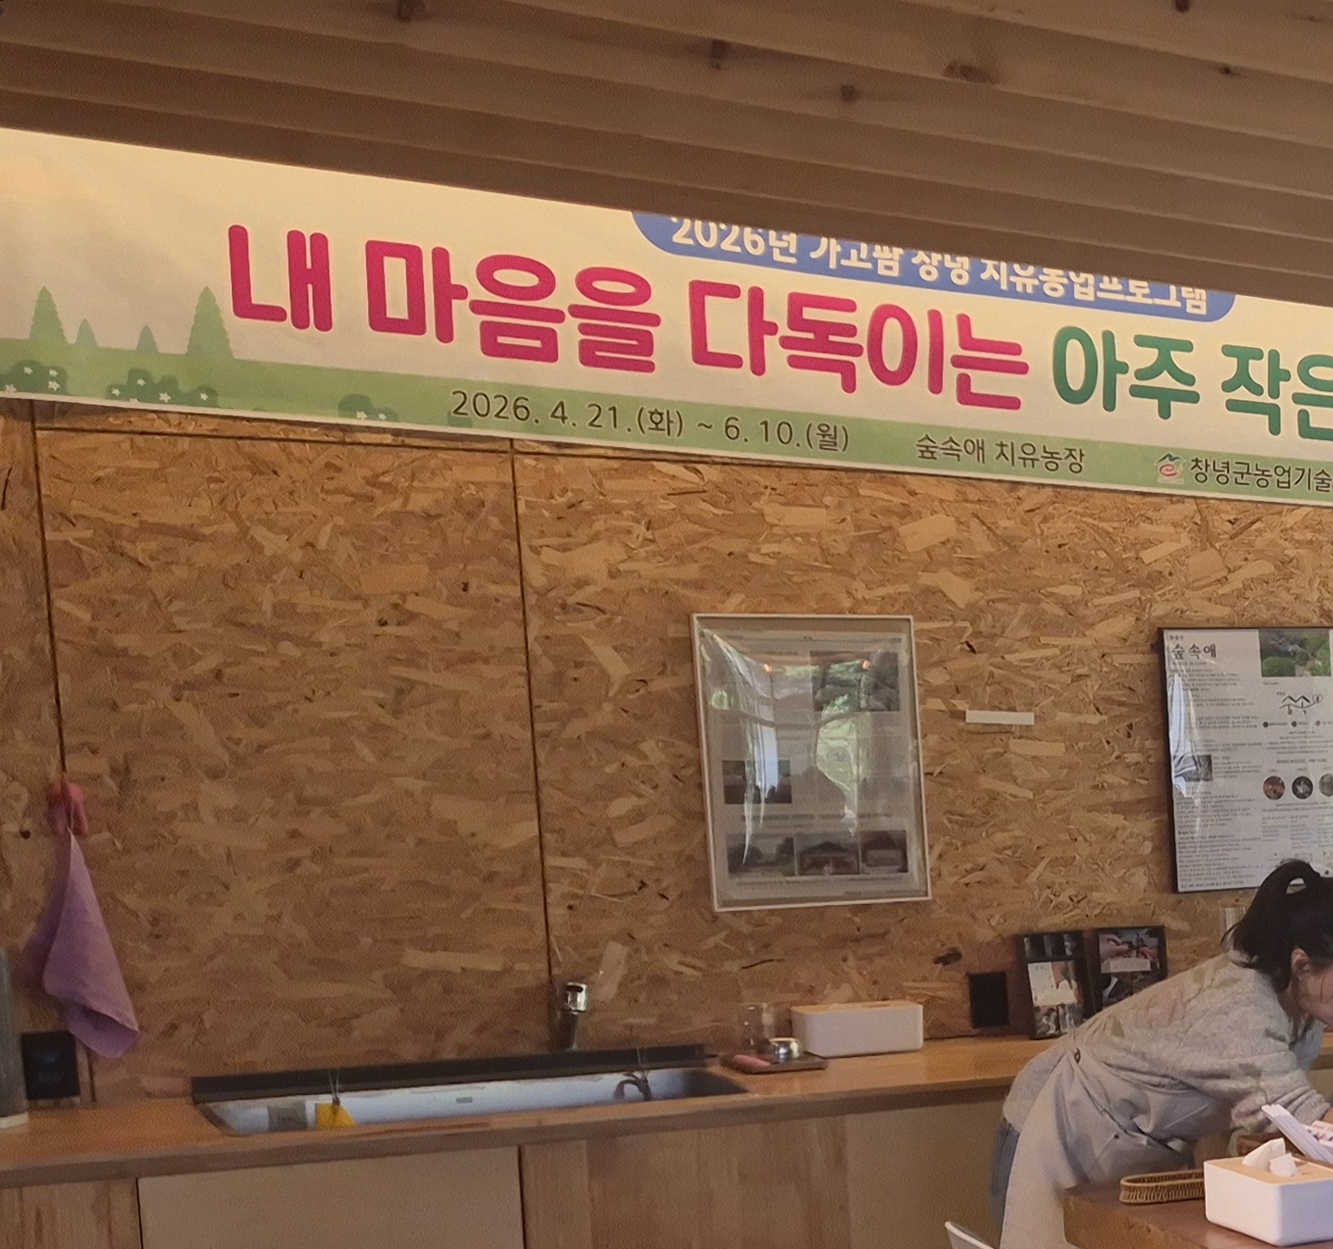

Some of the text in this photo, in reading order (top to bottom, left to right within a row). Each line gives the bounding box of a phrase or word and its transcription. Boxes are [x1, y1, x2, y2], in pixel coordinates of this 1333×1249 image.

[227, 224, 333, 332] 내
[364, 239, 661, 374] 마음을
[688, 279, 1030, 411] 다독이는
[1051, 325, 1201, 420] 아주
[914, 433, 1086, 475] 숲속애 치유농장
